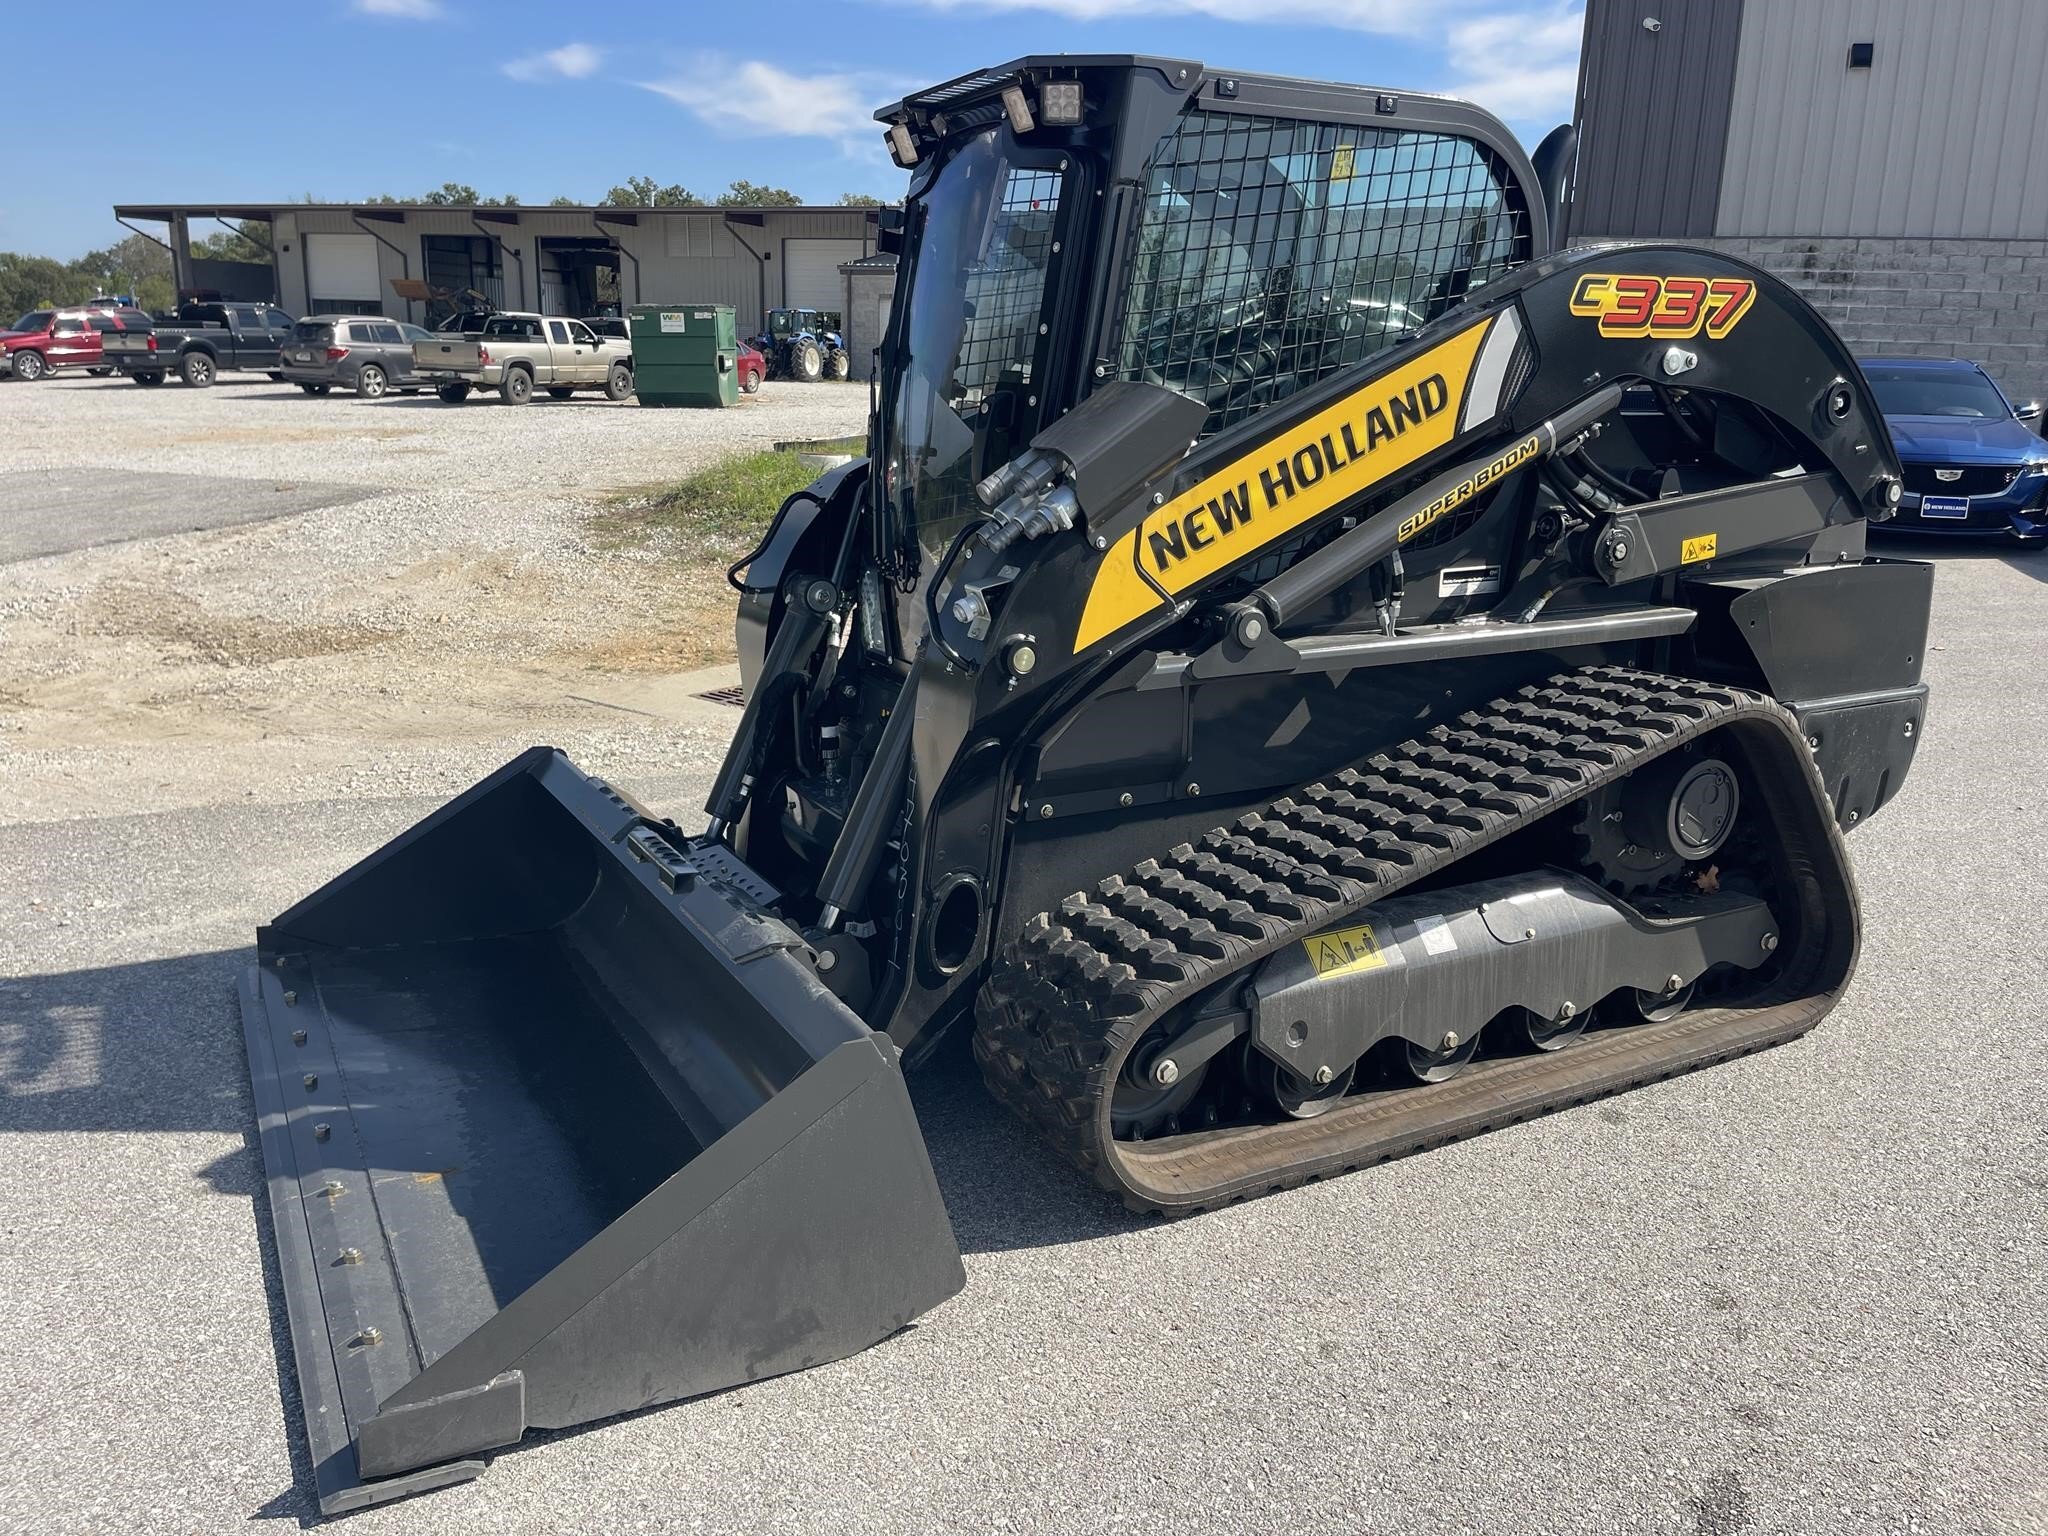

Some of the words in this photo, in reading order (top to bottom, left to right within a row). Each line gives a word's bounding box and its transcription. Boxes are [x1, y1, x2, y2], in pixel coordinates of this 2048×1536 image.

[1570, 273, 1757, 340] C337
[1146, 480, 1254, 571] NEW
[1258, 372, 1450, 512] HOLLAND
[1398, 479, 1474, 542] SUPER
[1474, 436, 1539, 492] BOOM
